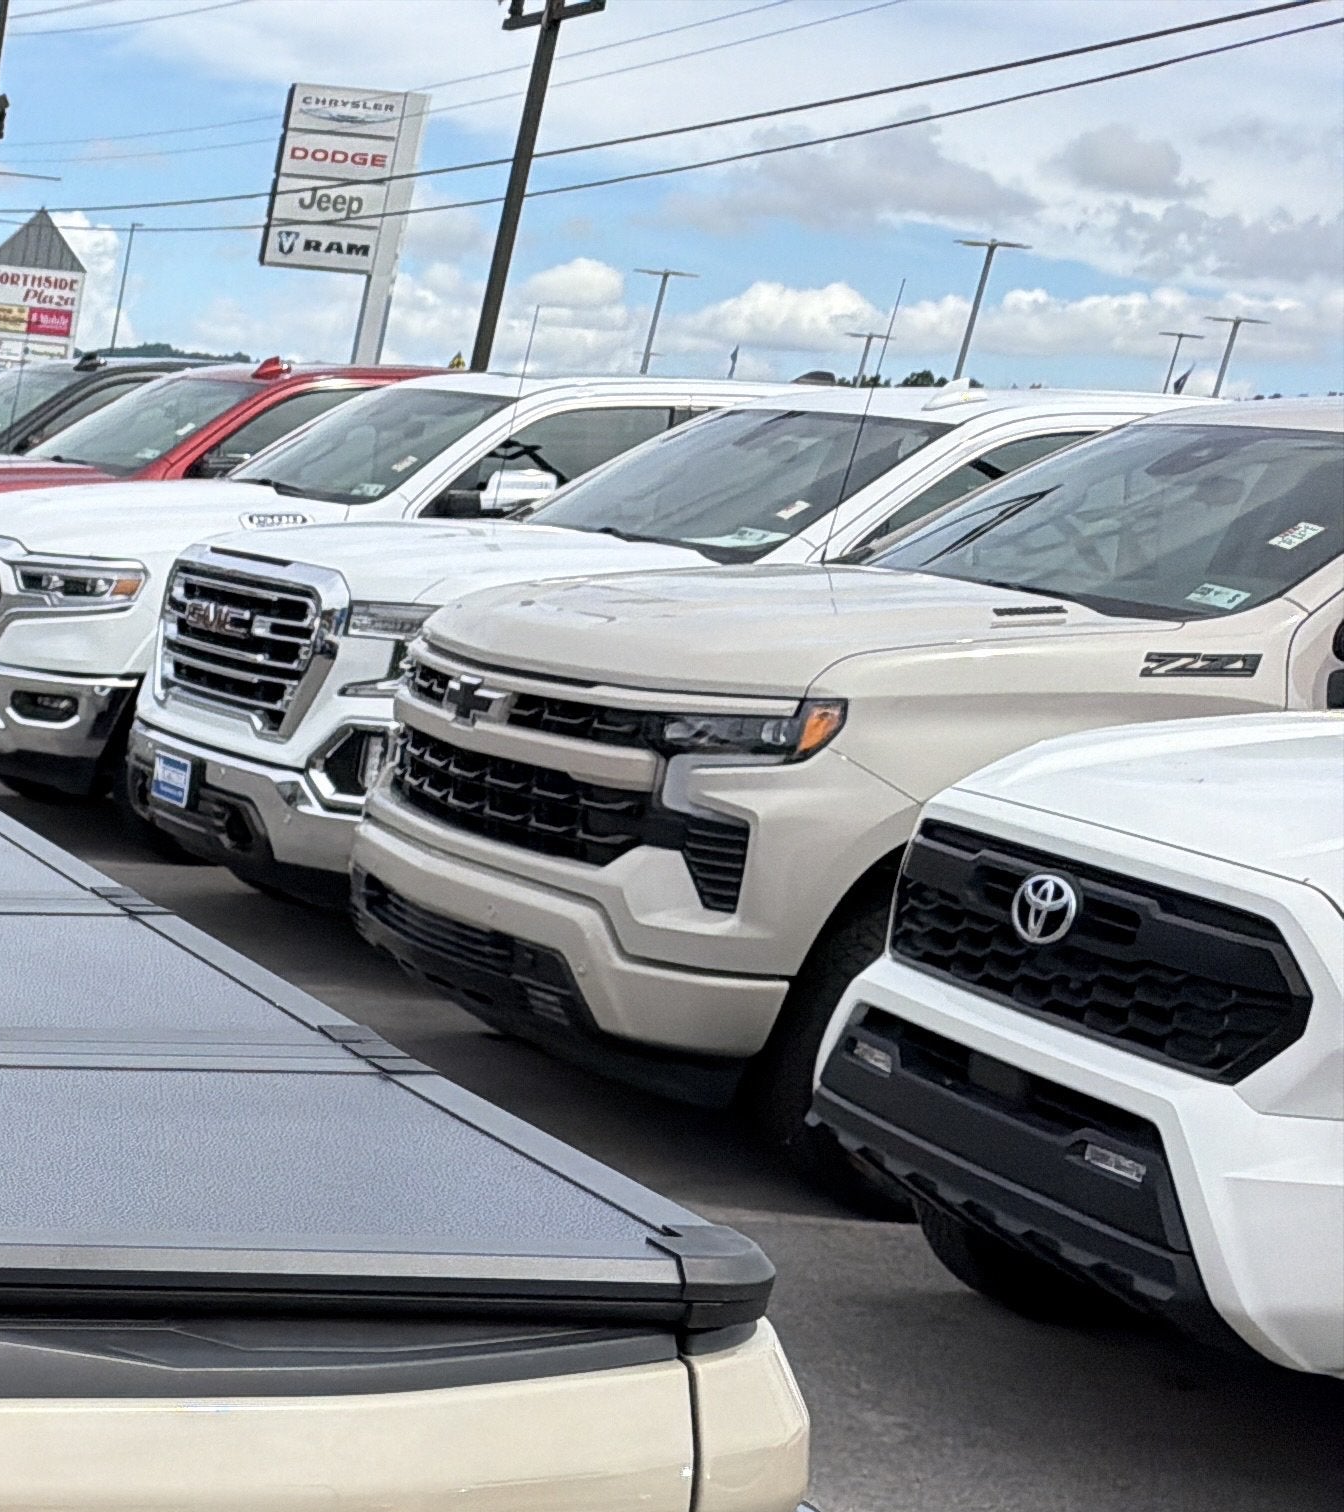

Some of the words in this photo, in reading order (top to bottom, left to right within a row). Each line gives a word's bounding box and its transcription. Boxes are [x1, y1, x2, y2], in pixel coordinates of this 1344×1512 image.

[302, 96, 395, 112] CHRYSLER
[290, 146, 388, 168] DODGE
[298, 188, 364, 219] Jeep
[303, 239, 371, 257] RAM
[22, 288, 76, 307] Plaza
[184, 600, 251, 640] GMC
[1139, 652, 1263, 678] Z71
